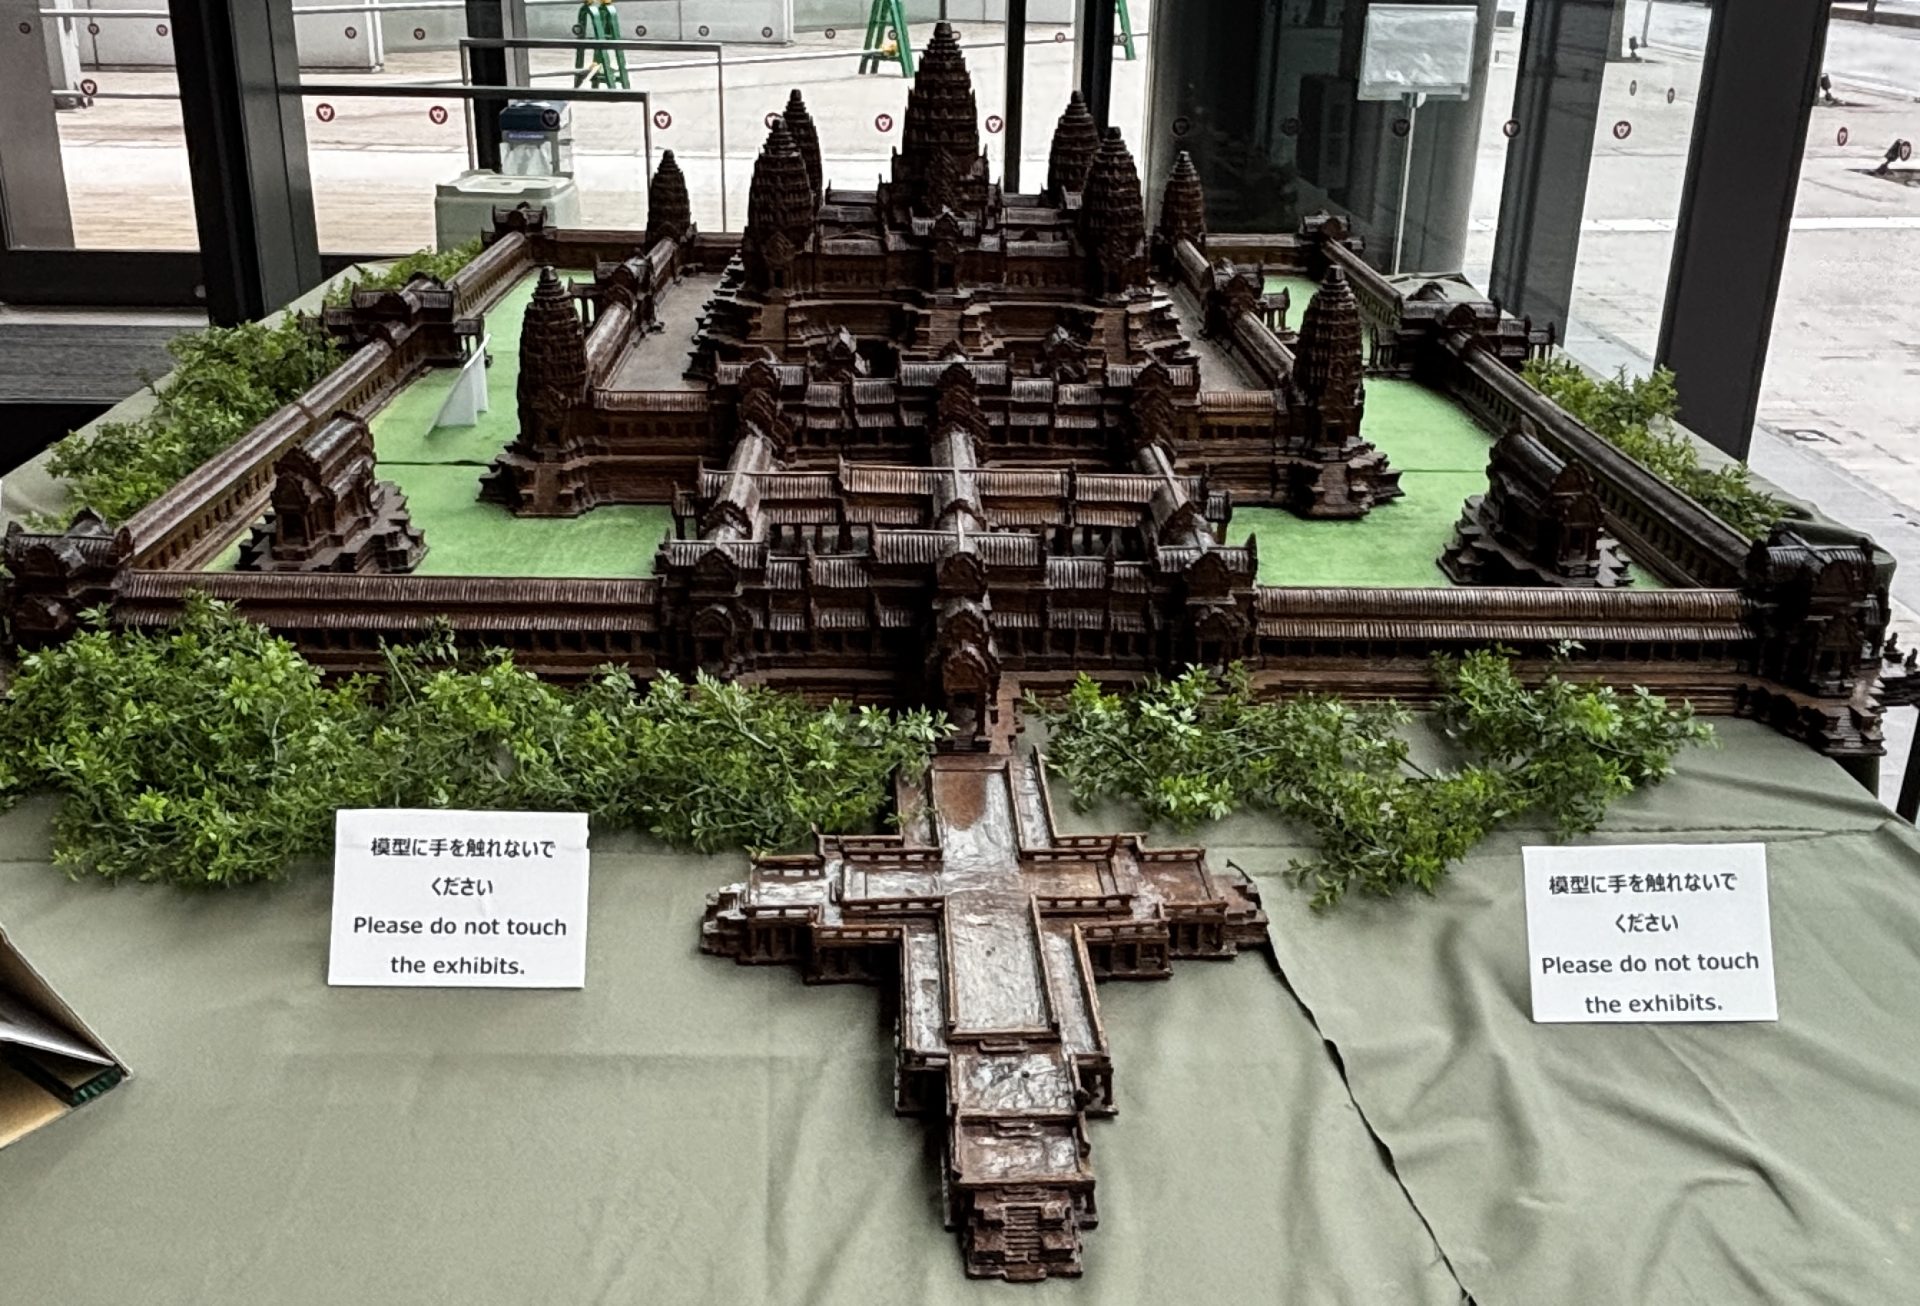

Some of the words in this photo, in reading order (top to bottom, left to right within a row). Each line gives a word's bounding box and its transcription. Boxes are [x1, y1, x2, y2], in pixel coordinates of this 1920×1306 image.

[371, 837, 556, 858] 模型に手を触れないで
[431, 876, 493, 896] ください
[1549, 873, 1737, 894] 模型に手を触れないで
[353, 916, 423, 934] Please
[430, 916, 457, 935] do
[464, 918, 500, 935] not
[506, 918, 567, 936] touch
[1615, 913, 1679, 933] ください
[390, 955, 426, 974] the
[433, 956, 525, 975] exhibits.
[1541, 956, 1613, 975] Please
[1619, 954, 1647, 973] do
[1654, 954, 1692, 972] not
[1697, 951, 1759, 971] touch
[1584, 995, 1622, 1014] the
[1628, 993, 1723, 1013] exhibits.
